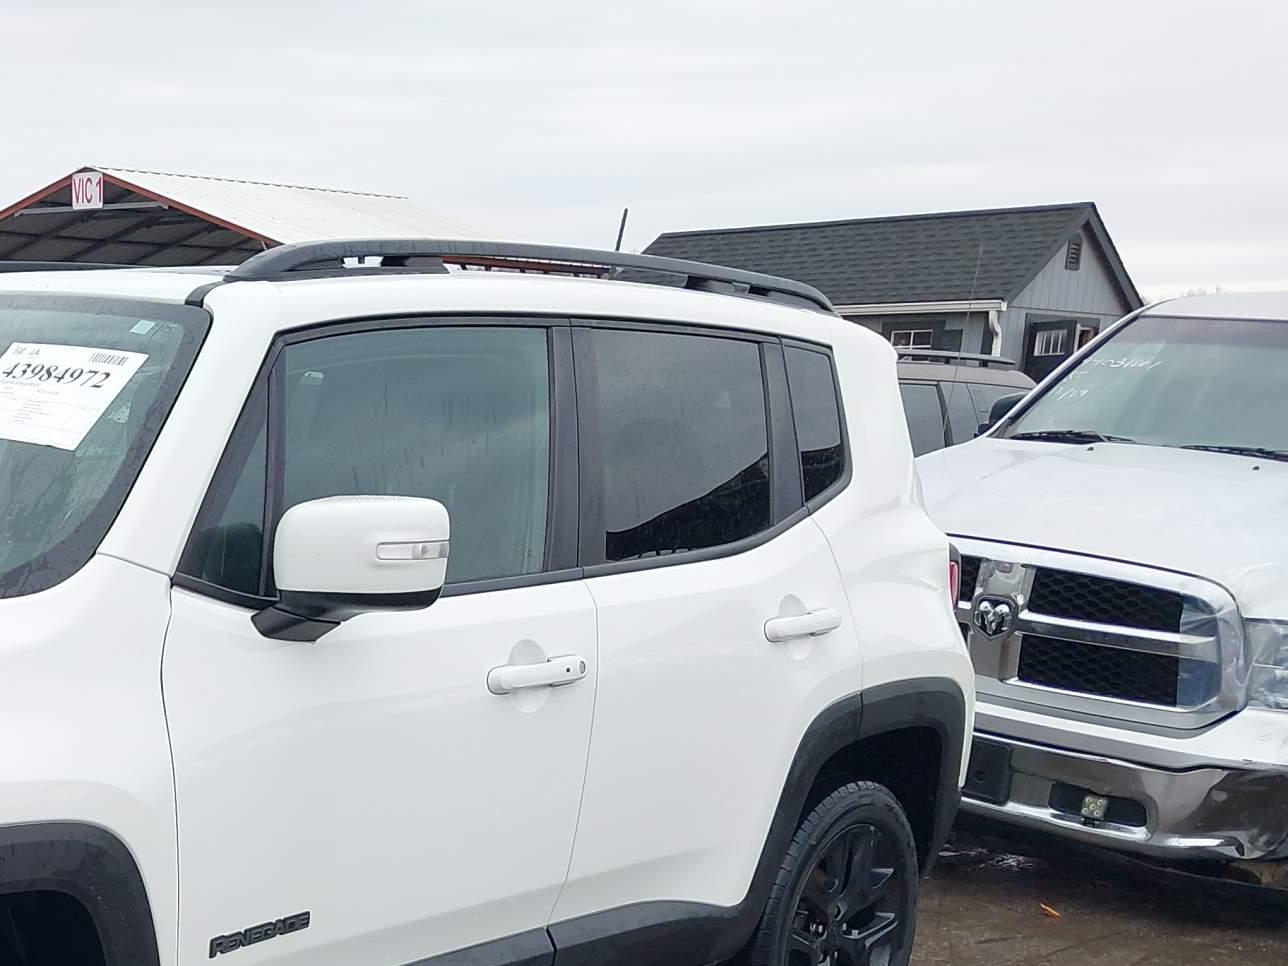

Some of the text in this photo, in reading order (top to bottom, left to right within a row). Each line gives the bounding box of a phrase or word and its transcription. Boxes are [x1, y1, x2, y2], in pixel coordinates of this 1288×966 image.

[73, 176, 102, 204] VIC 1
[2, 362, 111, 389] 43984972
[208, 910, 311, 959] RENEGADE
